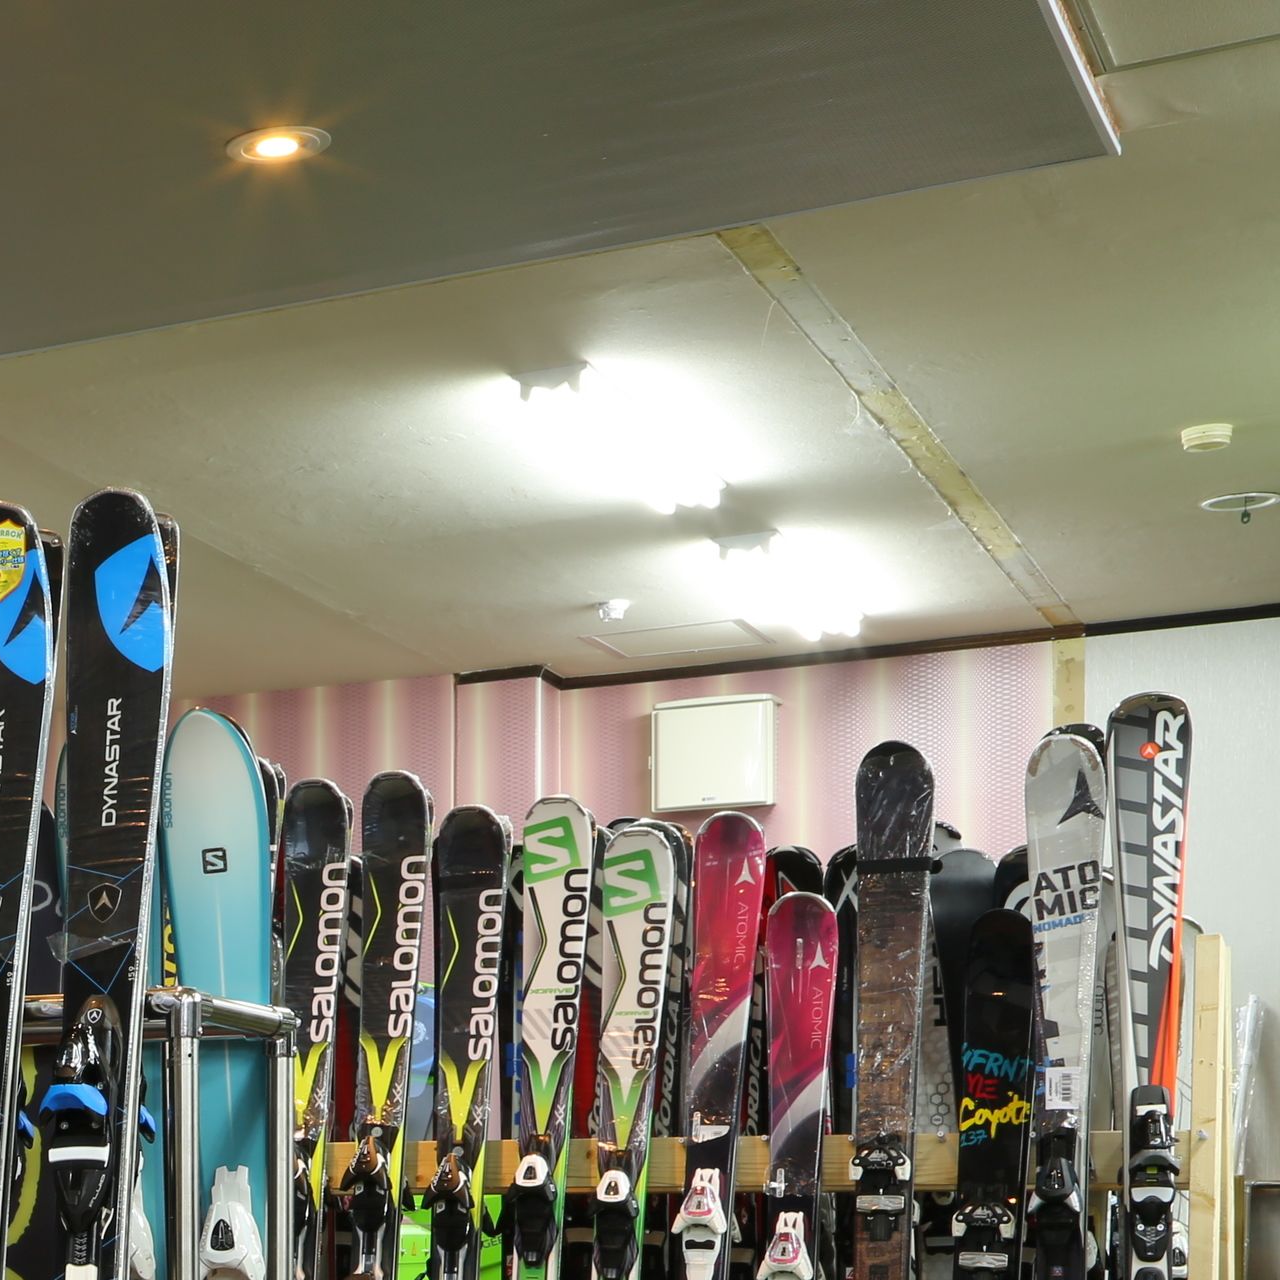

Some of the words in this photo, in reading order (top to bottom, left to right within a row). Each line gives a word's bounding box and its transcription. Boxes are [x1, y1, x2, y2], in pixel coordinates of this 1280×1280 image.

[101, 697, 123, 827] DYNASTAR
[162, 771, 174, 829] salomon
[1149, 710, 1186, 970] DYNASTAR
[310, 862, 347, 1042] salomon
[388, 855, 426, 1038] salomon
[468, 889, 503, 1061] salomon
[552, 868, 589, 1051] salomon
[632, 903, 668, 1070] salomon
[735, 902, 749, 965] ATOMIC
[745, 1029, 762, 1136] ORDICA
[809, 987, 823, 1049] ATOMIC
[958, 1091, 1032, 1139] Coyote
